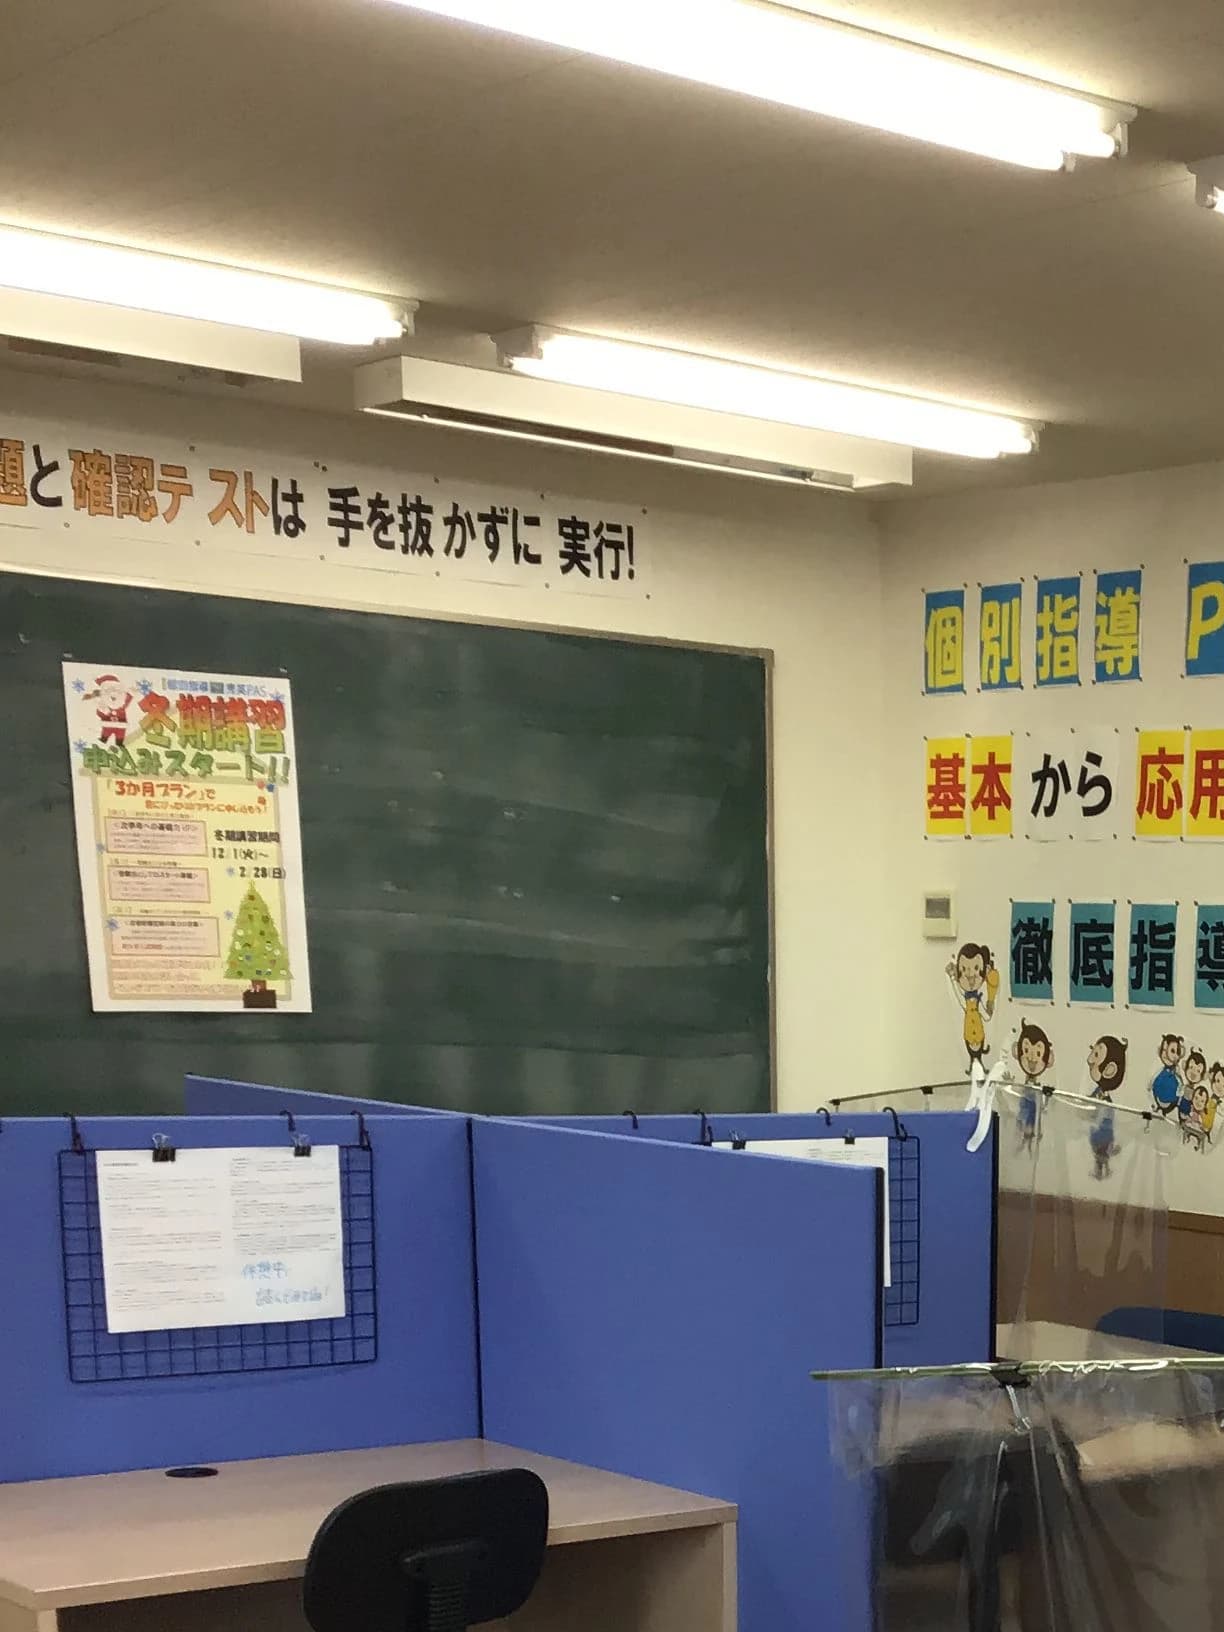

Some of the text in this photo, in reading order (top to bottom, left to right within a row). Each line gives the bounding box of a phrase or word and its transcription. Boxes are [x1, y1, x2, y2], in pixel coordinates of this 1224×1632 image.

[924, 587, 1141, 689] 個別指導
[137, 691, 287, 753] 冬期講習
[213, 829, 281, 843] 冬期講習期間
